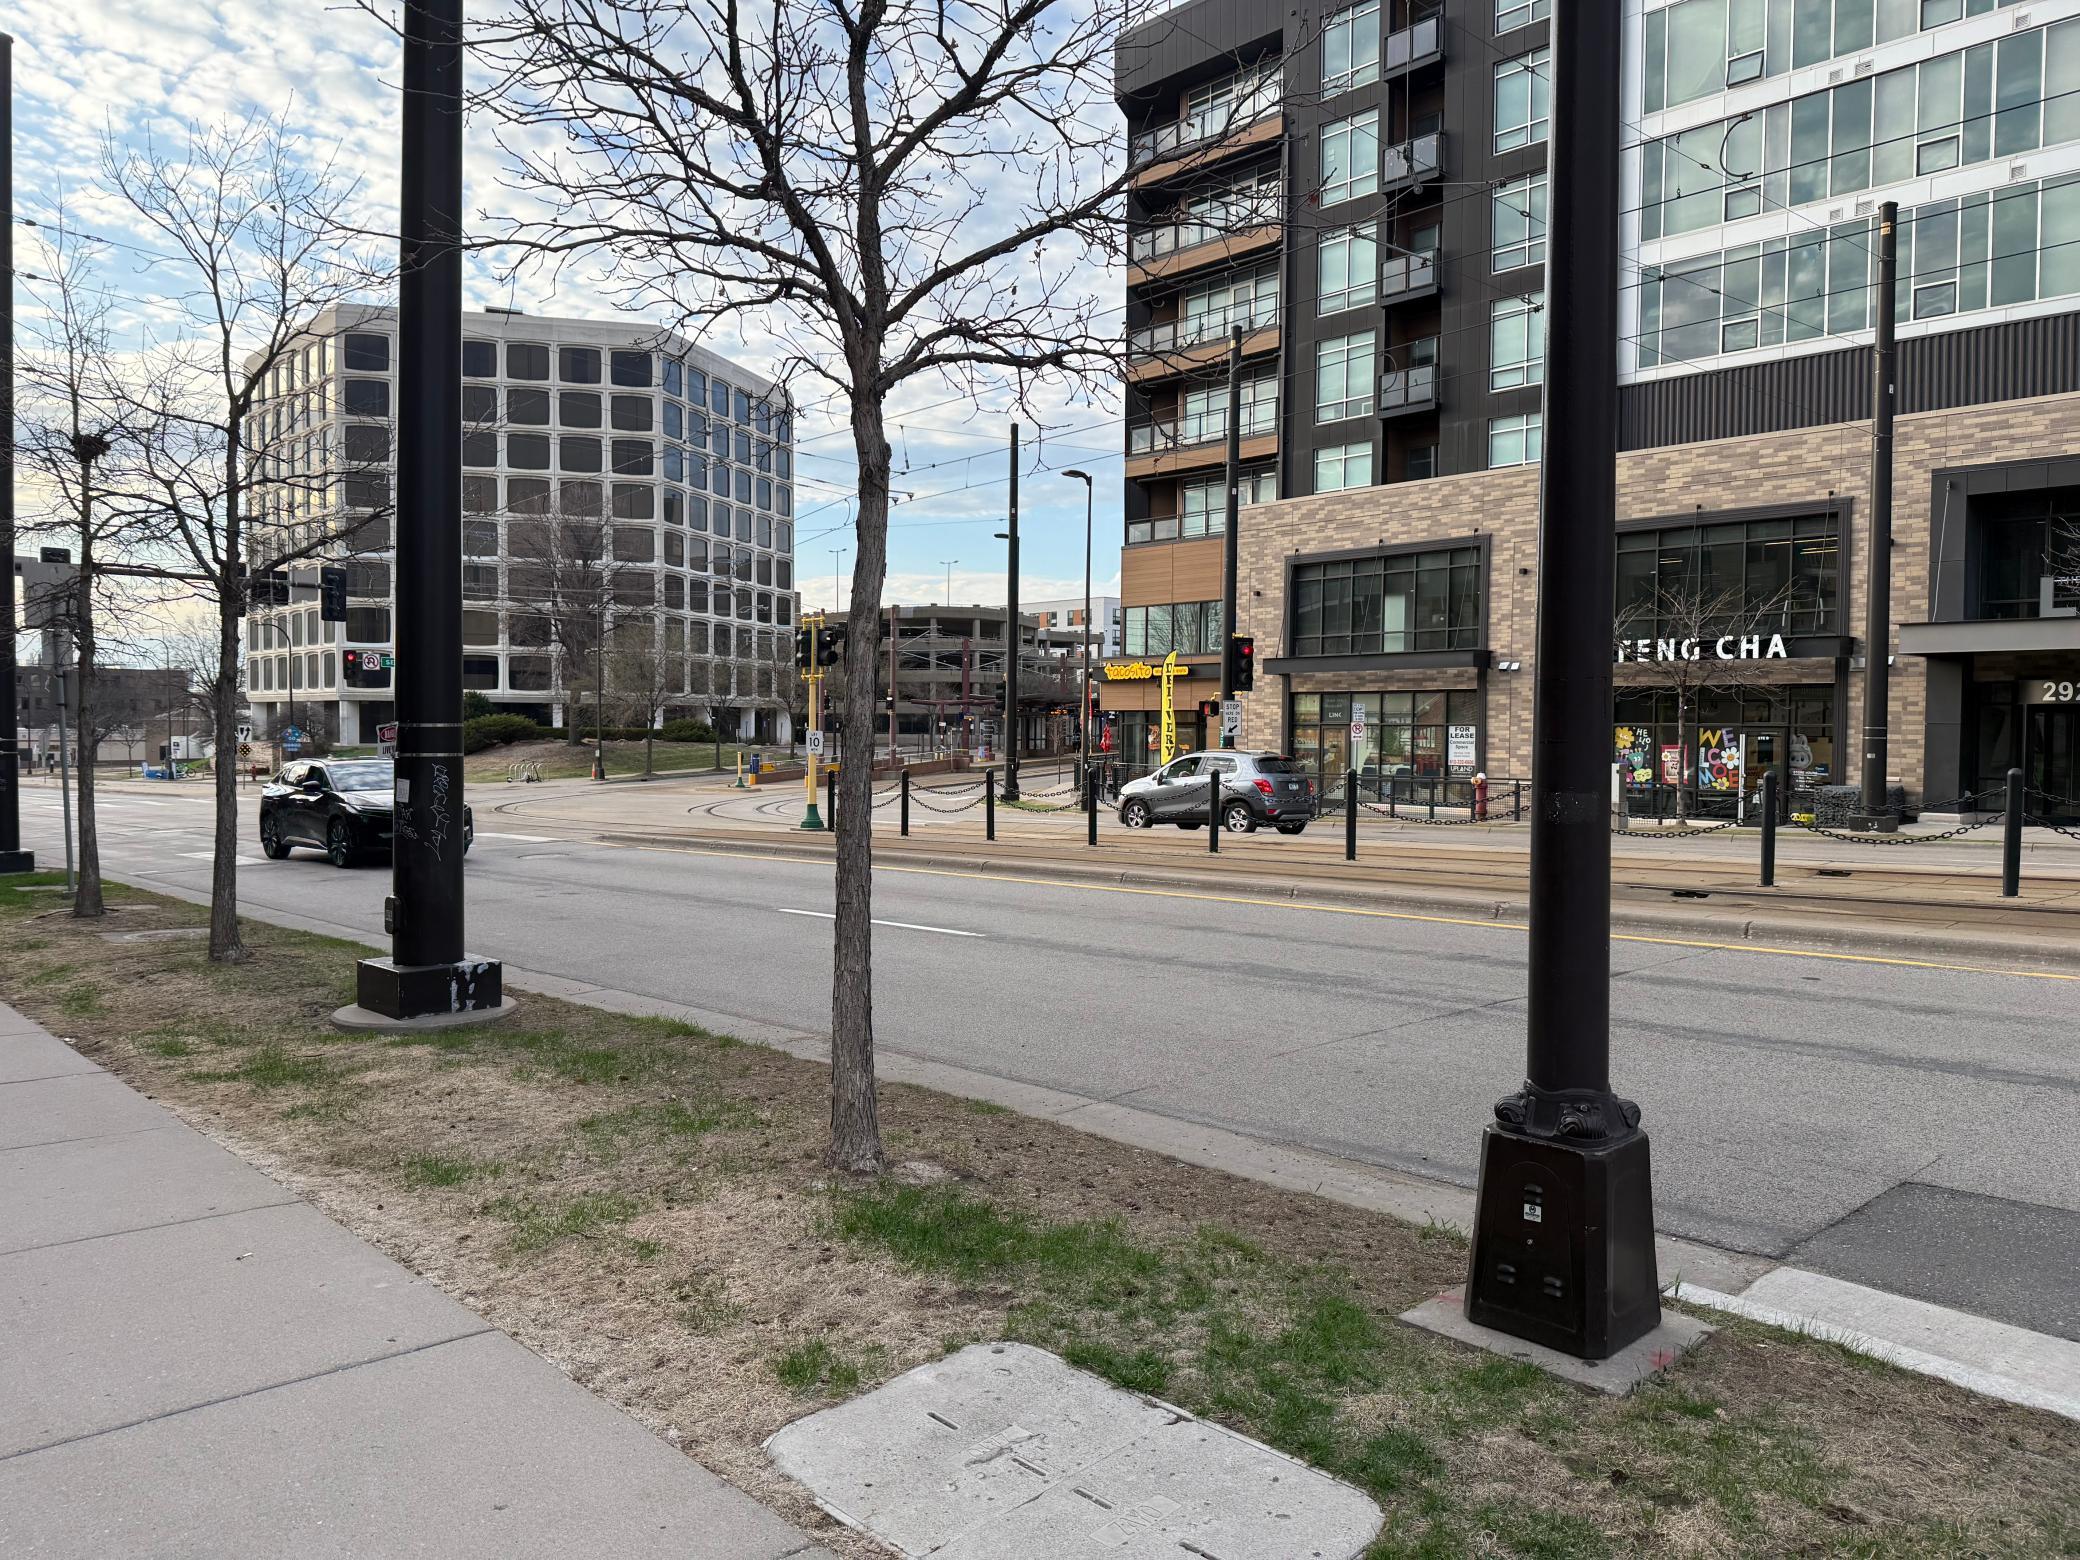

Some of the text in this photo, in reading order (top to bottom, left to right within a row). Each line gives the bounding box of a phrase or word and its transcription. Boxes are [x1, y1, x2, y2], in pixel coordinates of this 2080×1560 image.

[1716, 634, 1788, 660] CHA
[809, 737, 820, 748] 10
[1107, 1505, 1163, 1537] ZAYO
